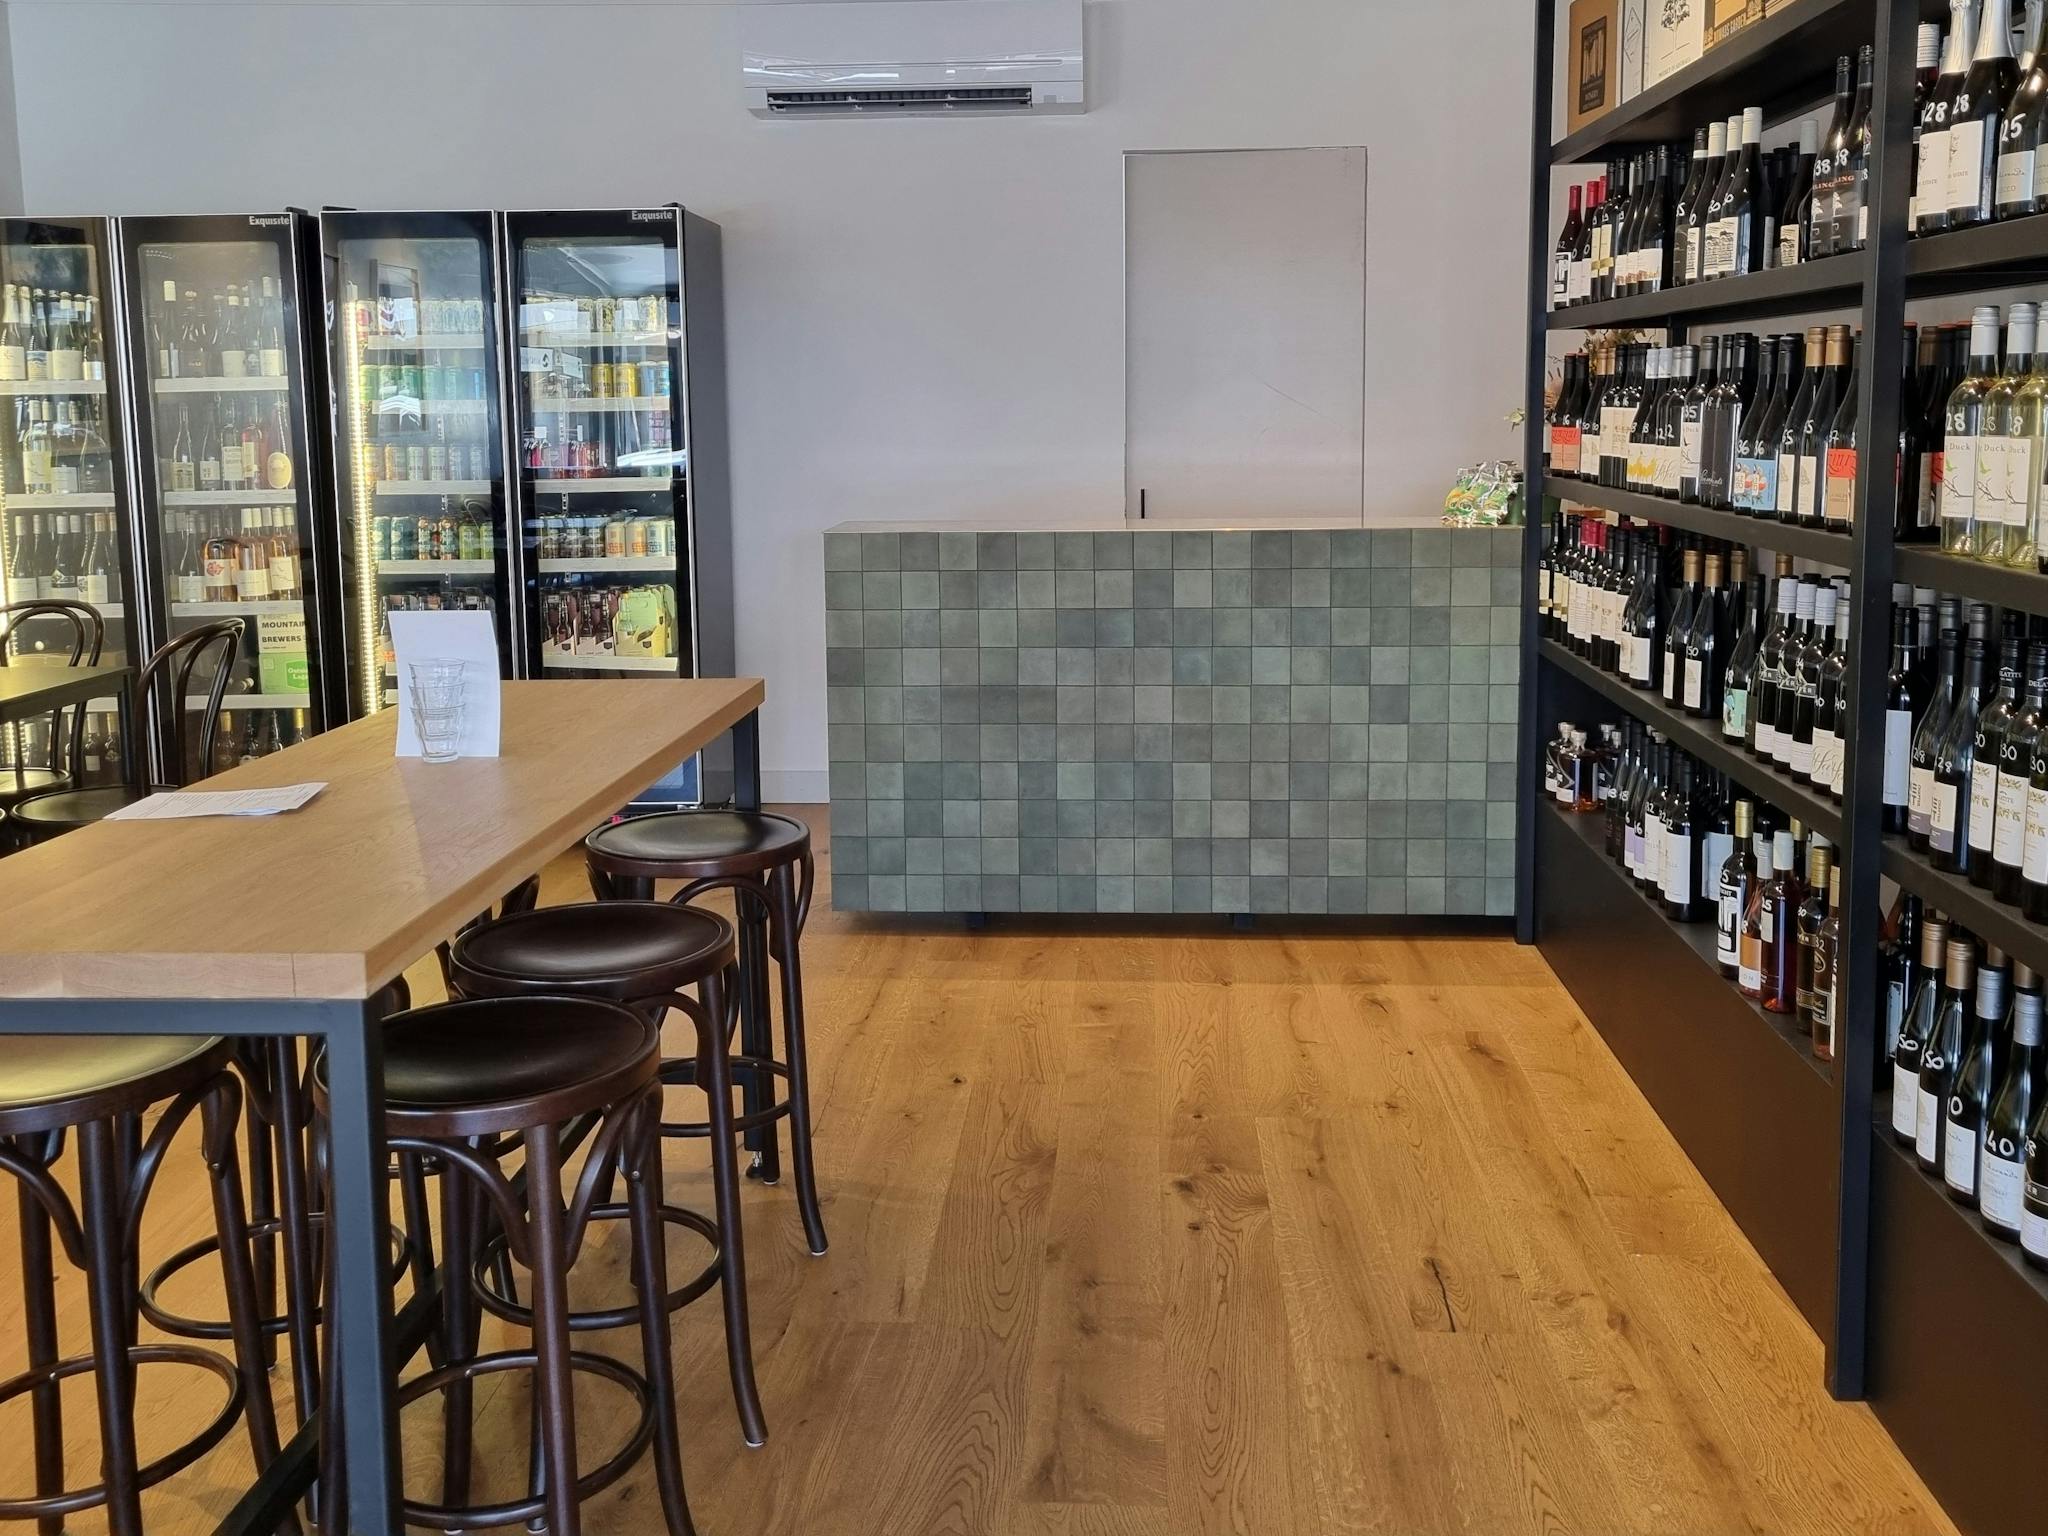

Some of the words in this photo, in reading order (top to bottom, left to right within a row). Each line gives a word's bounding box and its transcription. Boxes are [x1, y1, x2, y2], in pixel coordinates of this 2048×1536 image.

[1924, 101, 1948, 122] 28
[248, 215, 290, 228] Exquisite
[631, 210, 673, 223] Exquisite
[1946, 411, 1966, 432] 28
[1984, 444, 2006, 452] Duck
[261, 635, 302, 643] BREWERS
[1999, 744, 2018, 761] 30
[1937, 756, 1953, 773] 28
[2030, 755, 2046, 775] 30
[1987, 1129, 2016, 1157] 40
